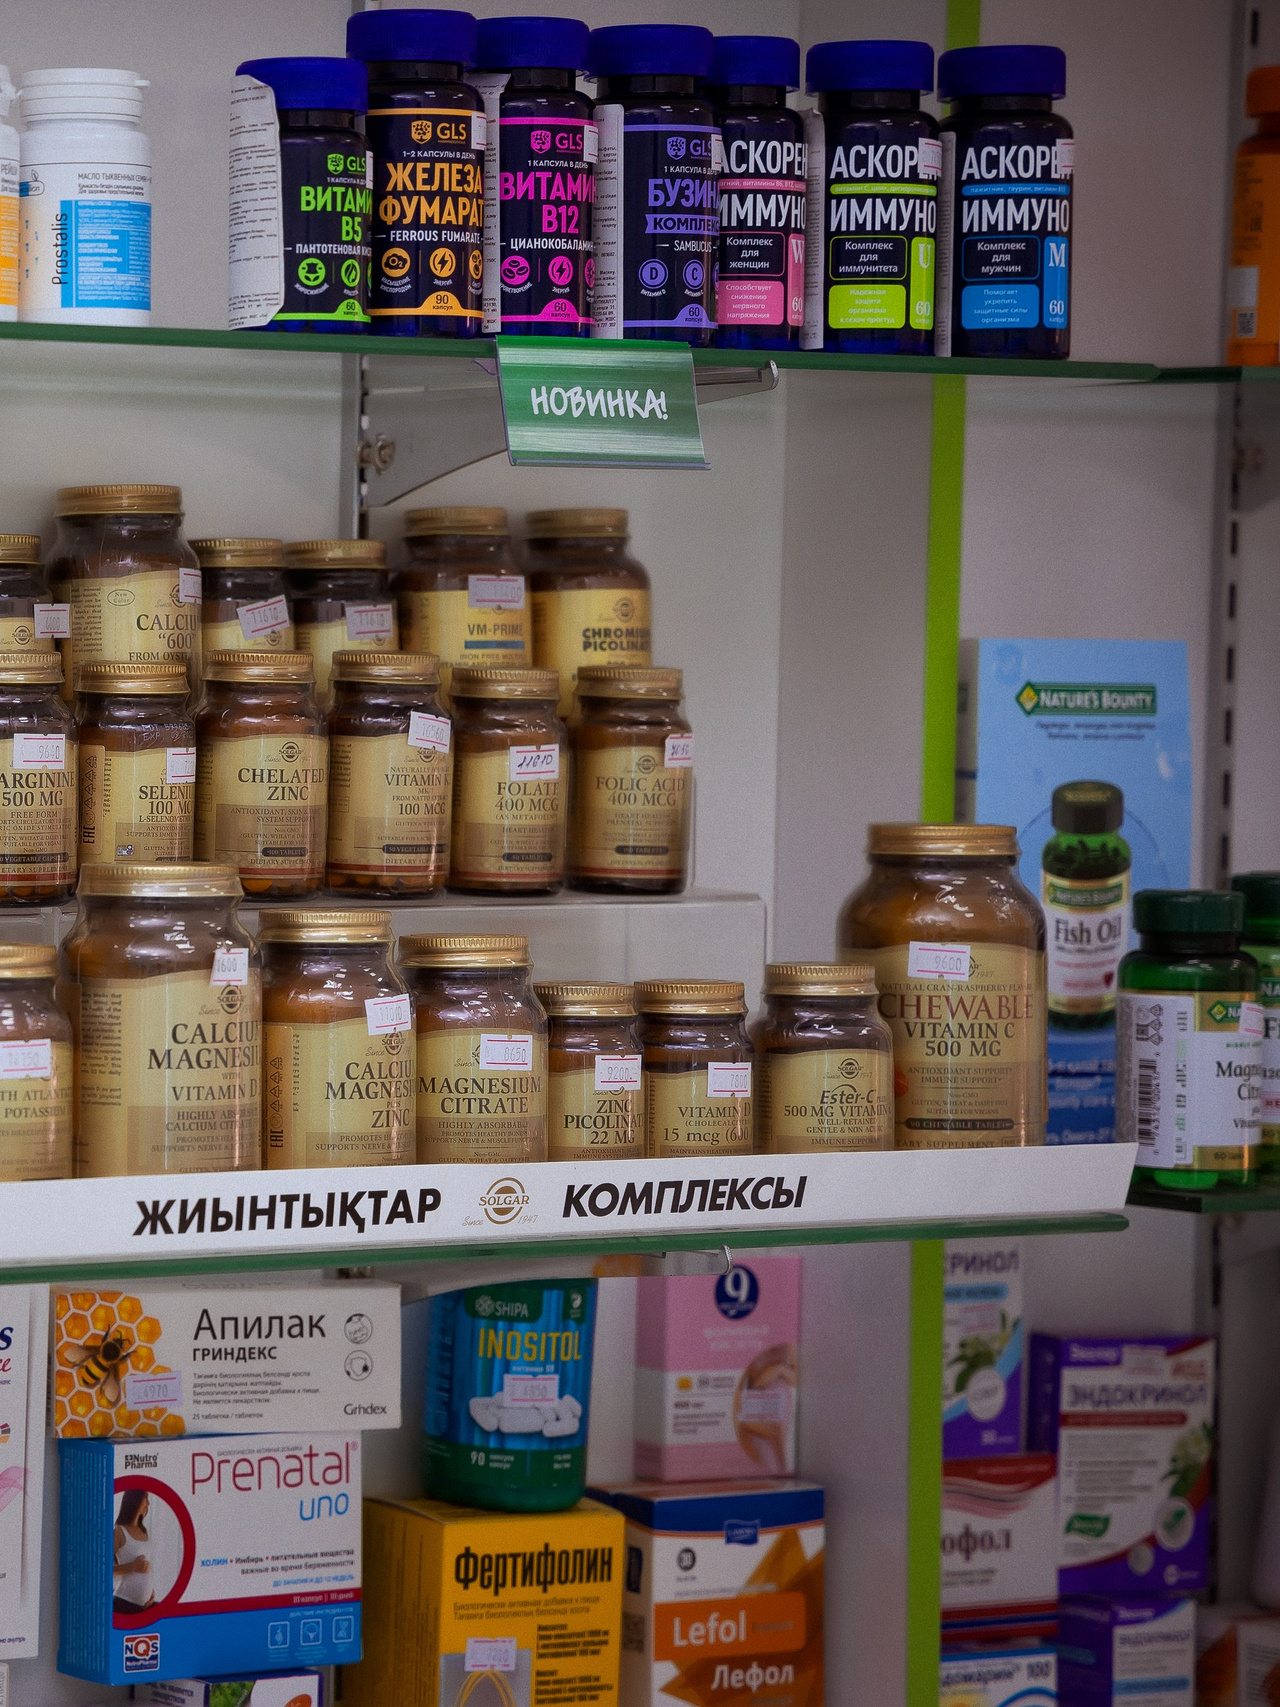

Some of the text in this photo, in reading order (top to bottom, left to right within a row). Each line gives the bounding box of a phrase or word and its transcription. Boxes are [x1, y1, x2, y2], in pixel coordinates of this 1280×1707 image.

[437, 122, 467, 140] GLS
[556, 133, 583, 150] GLS
[417, 151, 454, 159] КАПСУЛЫ
[830, 144, 937, 181] АСКОР
[534, 160, 568, 168] КАПСУЛА
[385, 162, 482, 193] ЖЕЛЕЗА
[379, 195, 484, 227] ФУМАРАТ
[830, 198, 936, 233] ИММУНО
[962, 198, 1069, 233] ИММУНО
[542, 205, 579, 234] B12
[341, 217, 362, 242] B5
[390, 231, 481, 245] FERROUS FUMARATE
[726, 237, 772, 248] Комплекс
[52, 212, 68, 285] Prostalis
[295, 244, 361, 255] ПАНТОТЕНОВАЯ
[674, 240, 712, 252] SAMBUCUS
[792, 240, 804, 263] W
[845, 241, 892, 252] Комплекс
[978, 241, 1026, 252] Комплекс
[741, 249, 758, 259] для
[860, 252, 878, 262] для
[992, 252, 1010, 262] для
[1049, 244, 1065, 267] M
[729, 260, 769, 270] женщин
[839, 265, 898, 273] иммунитета
[982, 264, 1021, 274] мужчин
[436, 294, 449, 304] 90
[1049, 300, 1064, 315] 60
[531, 386, 668, 420] НОВИНКА!
[129, 652, 152, 661] FROM
[1040, 689, 1152, 710] NATURE'S BOUNTY
[238, 769, 324, 783] CHELATED
[385, 774, 439, 786] VITAMIN
[497, 782, 558, 796] FOLATE
[596, 777, 684, 792] FOLIC ACID
[2, 791, 63, 806] 500 MG
[267, 786, 309, 801] ZINC
[608, 794, 676, 806] 400 MCG
[149, 801, 172, 814] 100
[399, 803, 445, 815] 100 MCG
[495, 798, 558, 812] 400 MCG
[1055, 918, 1121, 944] Fish Oil
[934, 956, 962, 970] 9600
[878, 993, 1033, 1020] CHEWABLE
[904, 1022, 1015, 1039] VITAMIN C
[504, 1047, 526, 1061] 8650
[925, 1041, 1001, 1057] 500 MG
[171, 1080, 244, 1101] VITAMIN
[419, 1076, 541, 1094] MAGNESIUM
[440, 1097, 528, 1114] CITRATE
[820, 1090, 875, 1106] Ester-C
[597, 1100, 632, 1113] ZINC
[678, 1106, 739, 1118] VITAMIN
[784, 1106, 834, 1117] 500 MG
[371, 1109, 410, 1128] ZINC
[590, 1131, 634, 1144] 22 MG
[664, 1128, 719, 1145] 15 mcg
[479, 1192, 529, 1208] SOLGAR
[562, 1176, 806, 1218] КОМПЛЕКСЫ
[133, 1188, 442, 1237] ЖИЫНТЫҚТАР
[725, 1267, 749, 1301] 9
[495, 1303, 528, 1317] SHIPA
[194, 1309, 326, 1340] Апилак
[478, 1328, 581, 1361] INOSITOL
[193, 1347, 277, 1362] ГРИНДЕКС
[143, 1385, 168, 1397] 4970
[1069, 1383, 1207, 1409] ЭНДОКРИНОЛ
[344, 1403, 387, 1415] Grindex
[125, 1460, 157, 1469] Pharma
[191, 1442, 350, 1494] Prenatal
[300, 1493, 349, 1520] uno
[455, 1542, 612, 1596] Фертифолин
[673, 1611, 746, 1648] Lefol
[711, 1665, 794, 1693] Лефол
